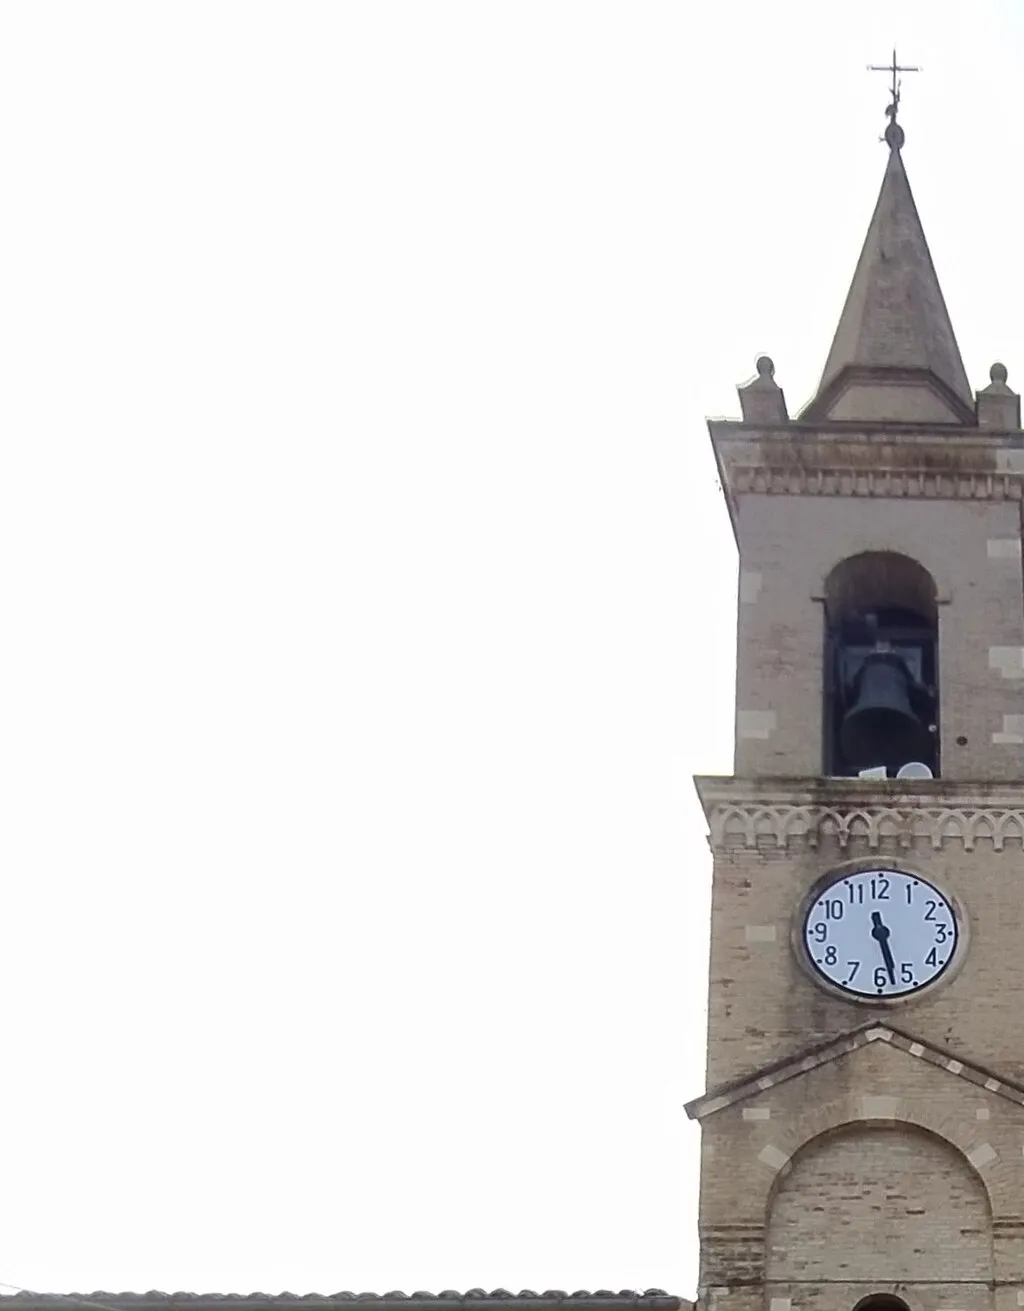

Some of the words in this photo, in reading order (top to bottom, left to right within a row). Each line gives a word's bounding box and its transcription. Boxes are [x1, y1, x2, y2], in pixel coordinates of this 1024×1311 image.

[848, 884, 863, 904] 11
[871, 879, 890, 900] 12
[906, 884, 911, 904] 1
[825, 900, 844, 920] 10
[924, 900, 937, 921] 2
[814, 922, 827, 943] 9
[934, 923, 946, 944] 3
[824, 946, 837, 966] 8
[925, 947, 937, 967] 4
[847, 961, 860, 982] 7
[874, 967, 887, 988] 6
[901, 963, 913, 983] 5
